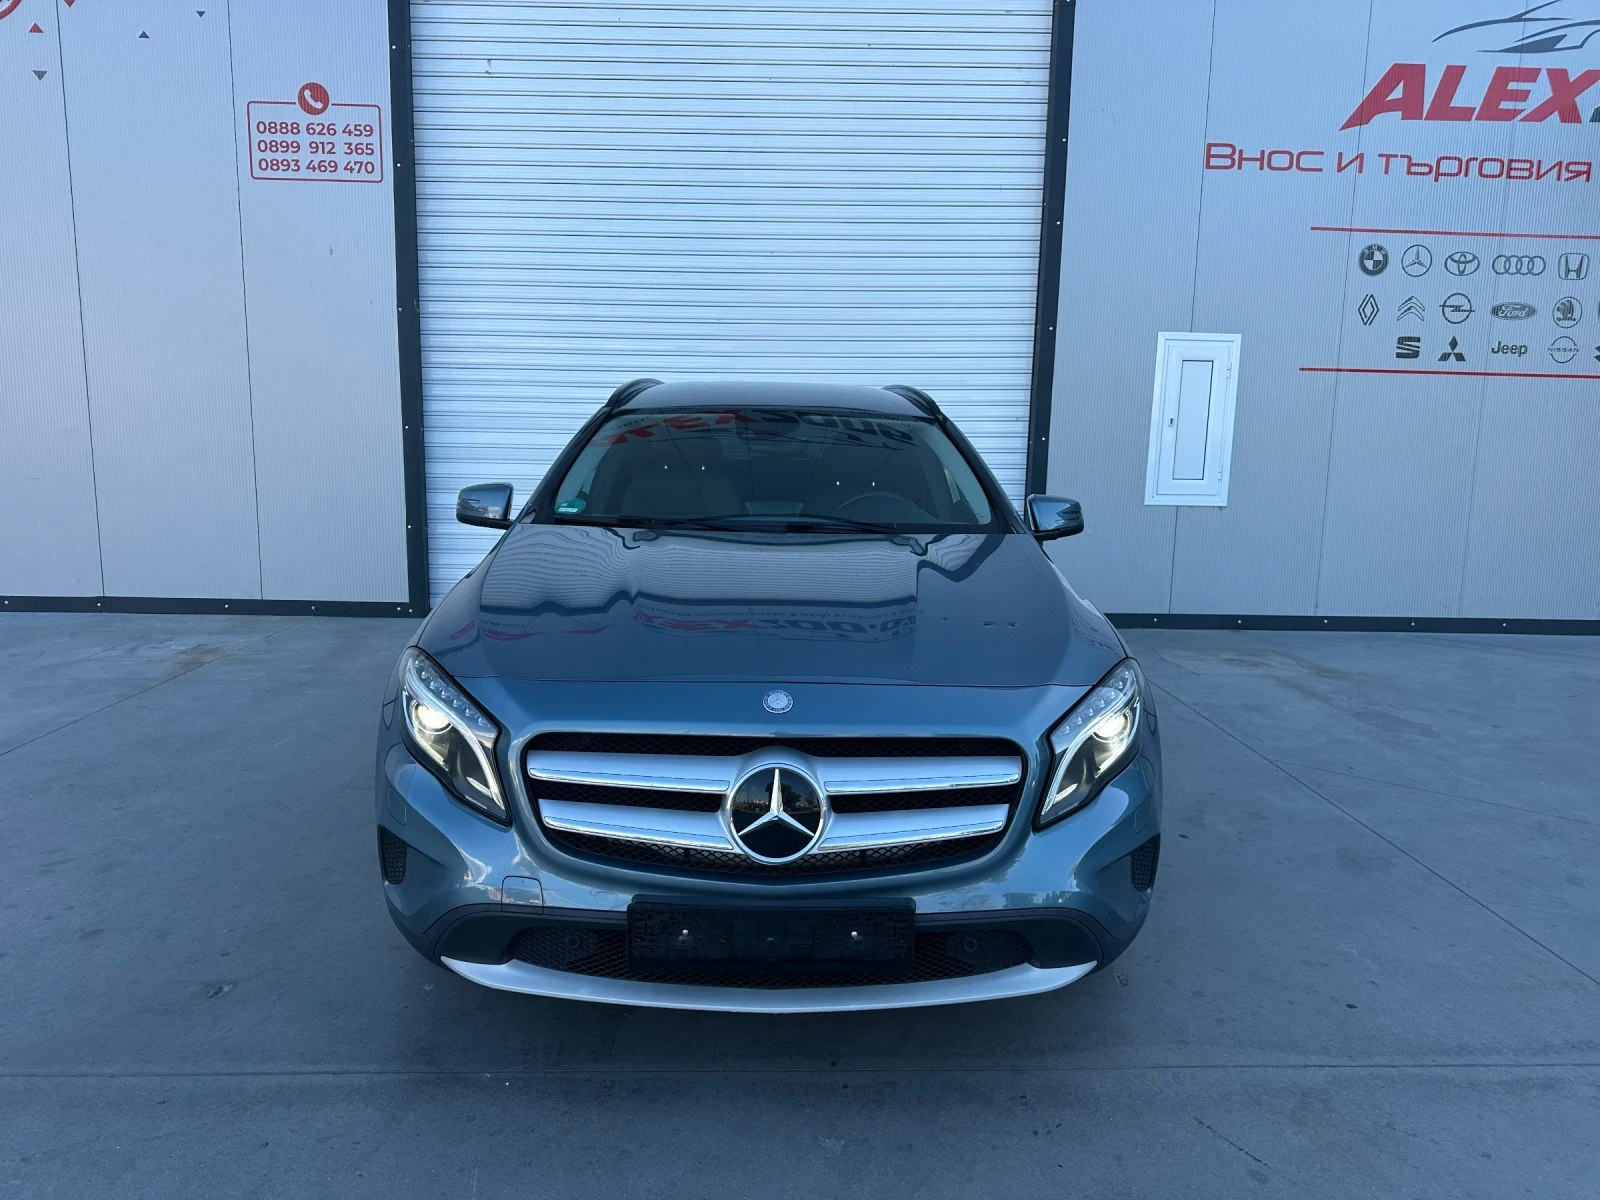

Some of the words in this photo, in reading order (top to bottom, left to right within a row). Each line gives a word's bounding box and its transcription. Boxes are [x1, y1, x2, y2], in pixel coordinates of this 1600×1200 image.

[1338, 62, 1600, 132] ALEX
[256, 121, 300, 135] 0888
[305, 122, 337, 136] 626
[341, 124, 374, 137] 459
[257, 139, 300, 153] 0899
[308, 141, 336, 155] 912
[343, 142, 375, 156] 365
[258, 158, 300, 172] 0893
[305, 159, 338, 173] 469
[343, 160, 375, 174] 470
[1205, 142, 1325, 173] Внос
[1336, 152, 1365, 174] и
[1377, 153, 1592, 182] търговия
[1498, 304, 1529, 317] Ford
[1491, 340, 1528, 357] Jeep
